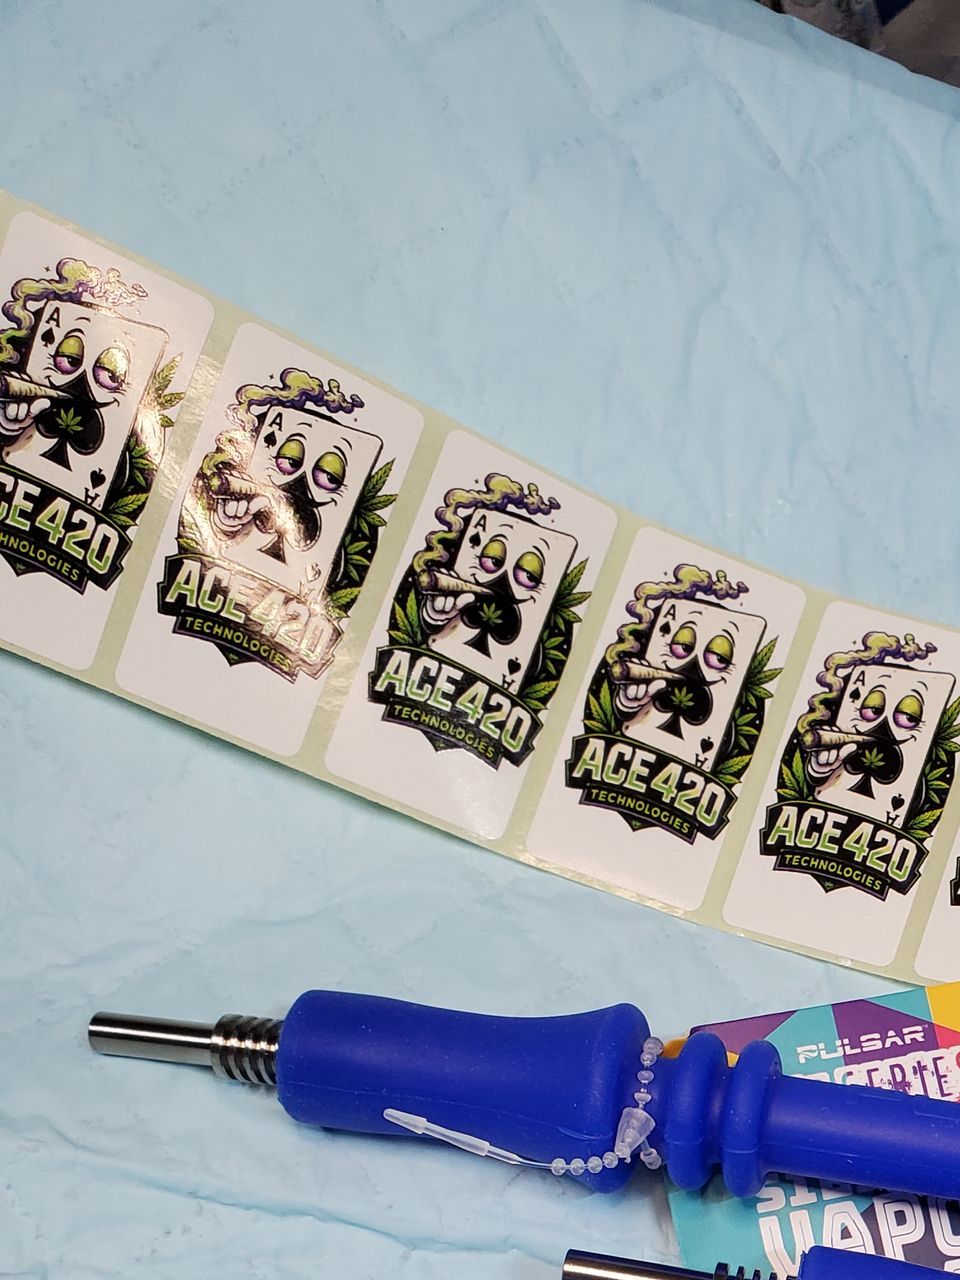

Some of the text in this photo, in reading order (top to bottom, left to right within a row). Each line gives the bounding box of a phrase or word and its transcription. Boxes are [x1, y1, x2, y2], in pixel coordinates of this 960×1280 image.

[48, 306, 61, 328] A
[270, 412, 284, 431] A
[35, 497, 120, 574] 420
[474, 514, 487, 532] A
[165, 559, 333, 665] ACE 420
[664, 604, 676, 620] A
[185, 616, 293, 670] TECHNOLOGIES
[853, 670, 865, 686] A
[375, 650, 532, 752] ACE 420
[394, 705, 494, 758] TECHNOLOGIES
[572, 738, 726, 826] ACE 420
[591, 789, 690, 834] TECHNOLOGIES
[766, 806, 917, 882] ACE 420
[784, 854, 882, 891] TECHNOLOGIES
[796, 1025, 925, 1063] PULSAR
